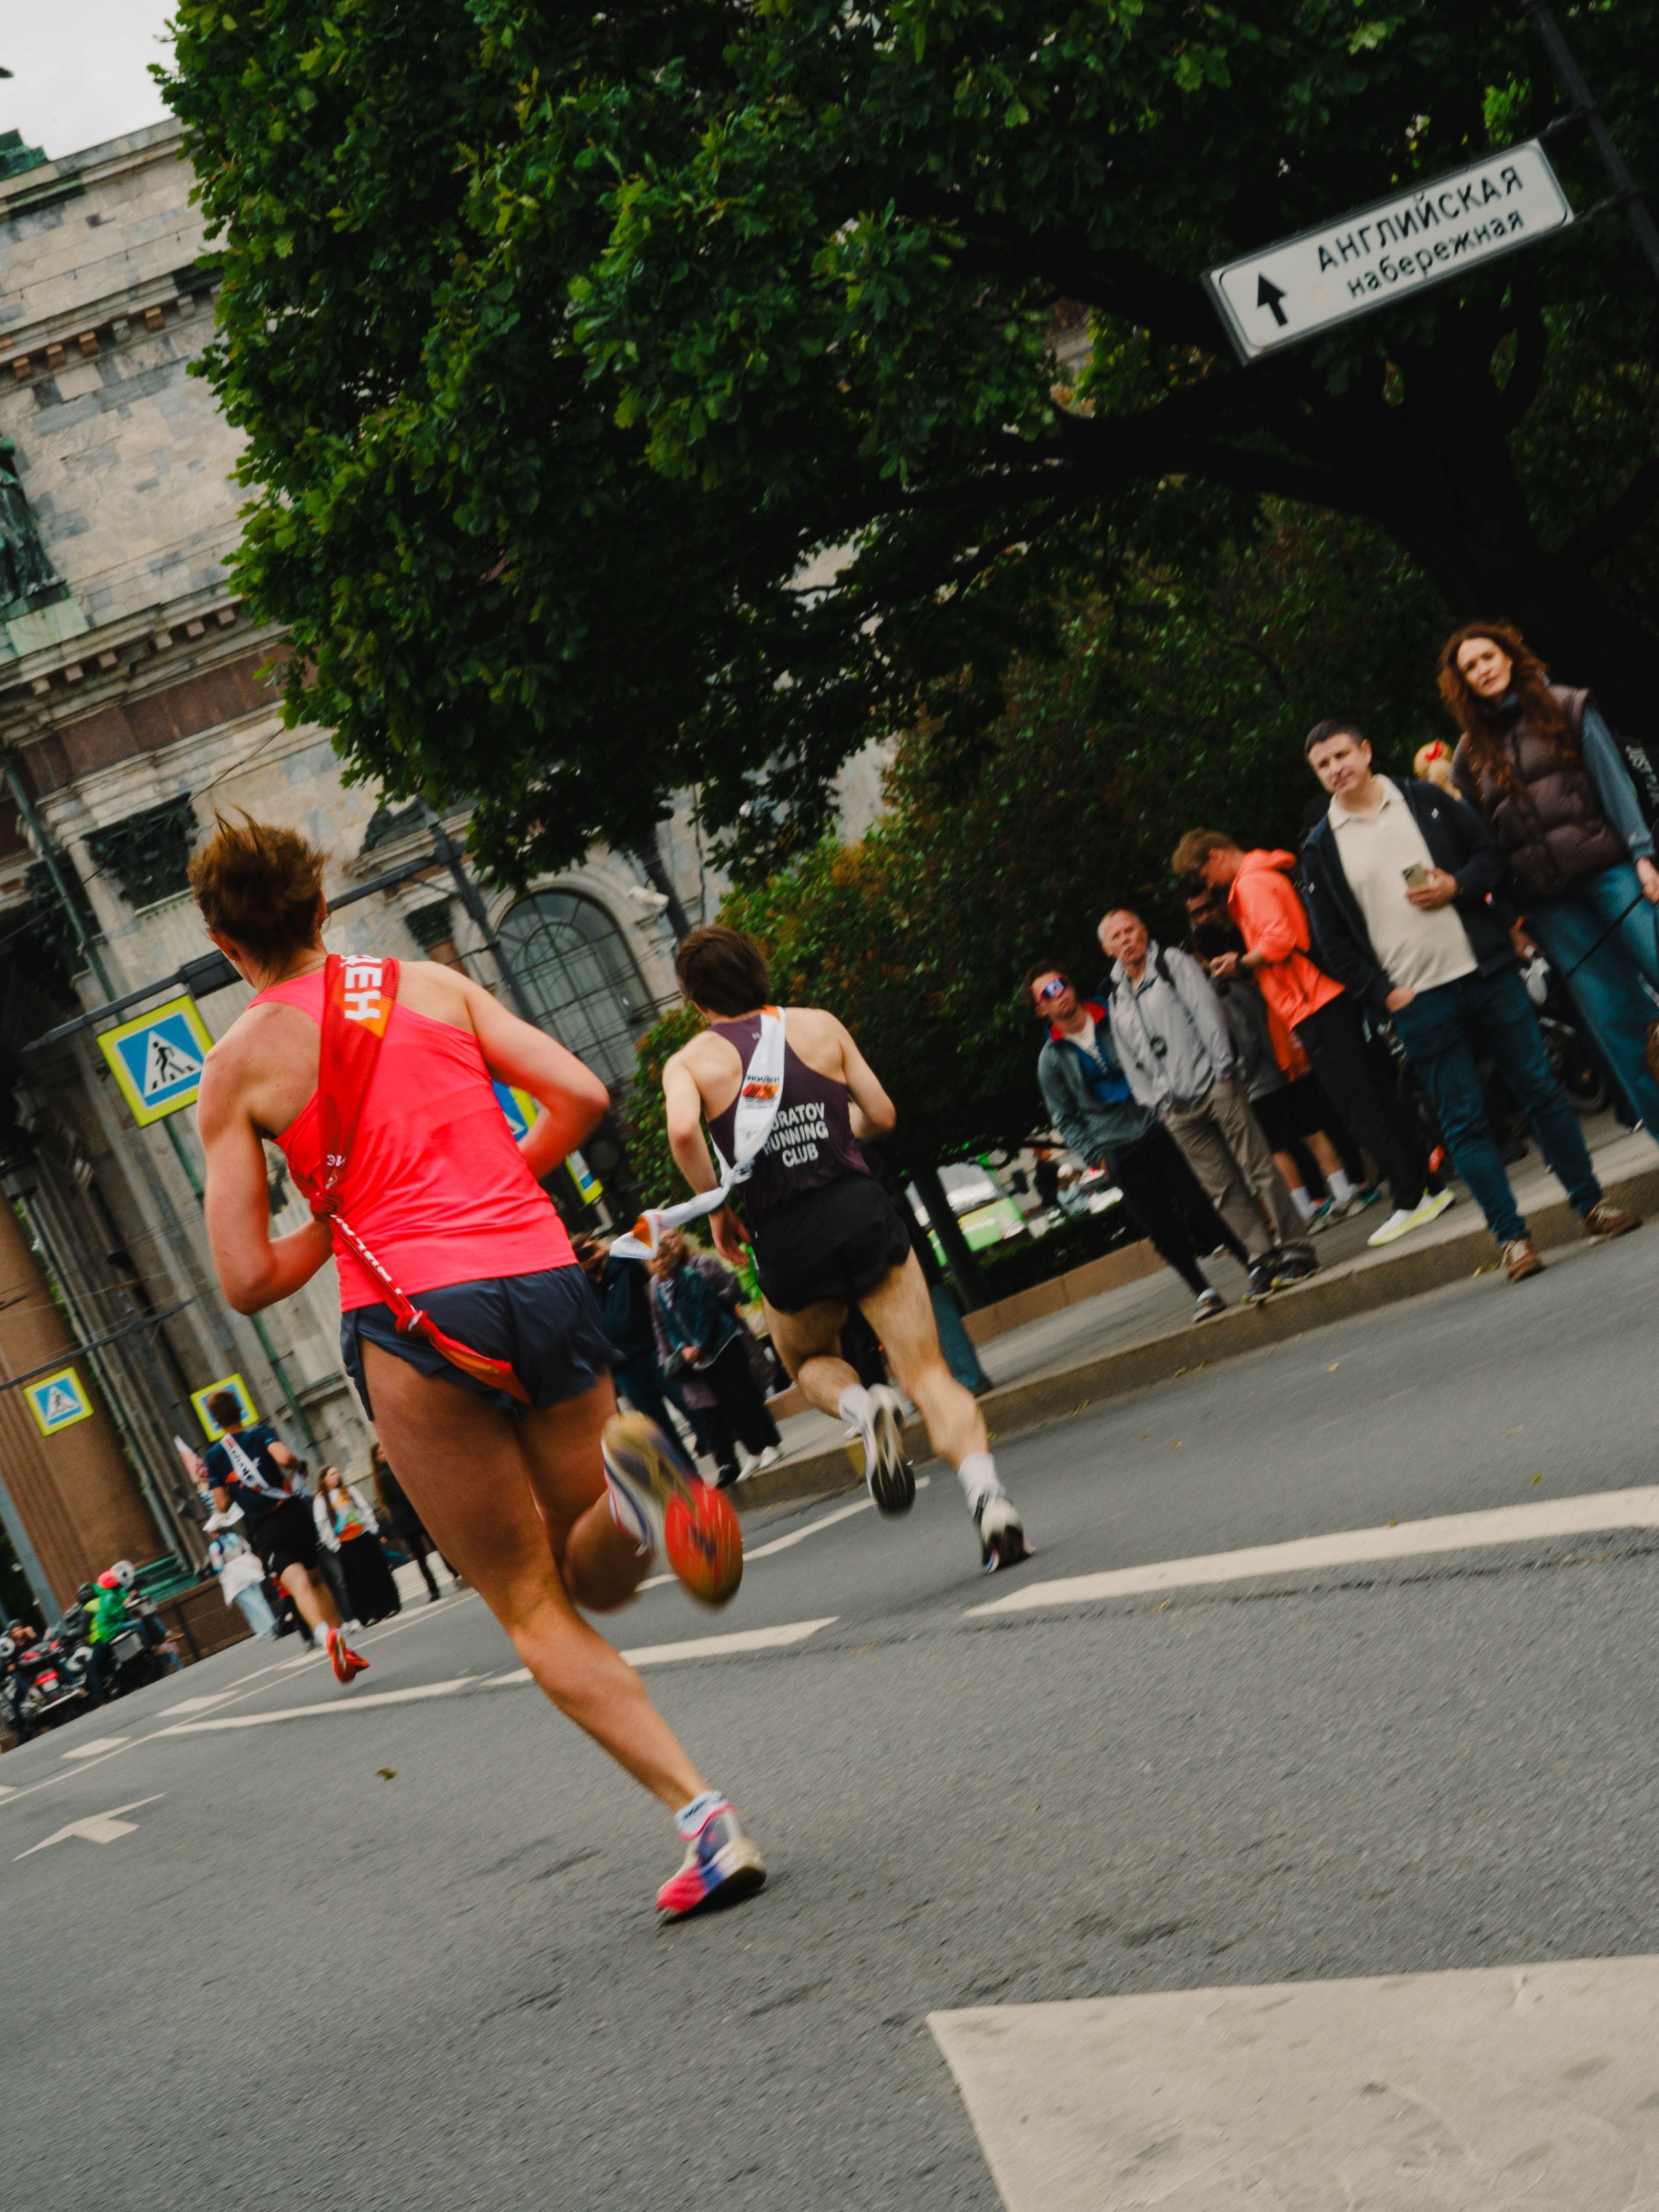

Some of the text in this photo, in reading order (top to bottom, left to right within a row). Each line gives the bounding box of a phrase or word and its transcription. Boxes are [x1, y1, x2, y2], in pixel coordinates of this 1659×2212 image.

[1317, 165, 1524, 274] АНГЛИЙСКАЯ
[1347, 209, 1524, 298] набережная
[782, 1142, 818, 1167] CLUB
